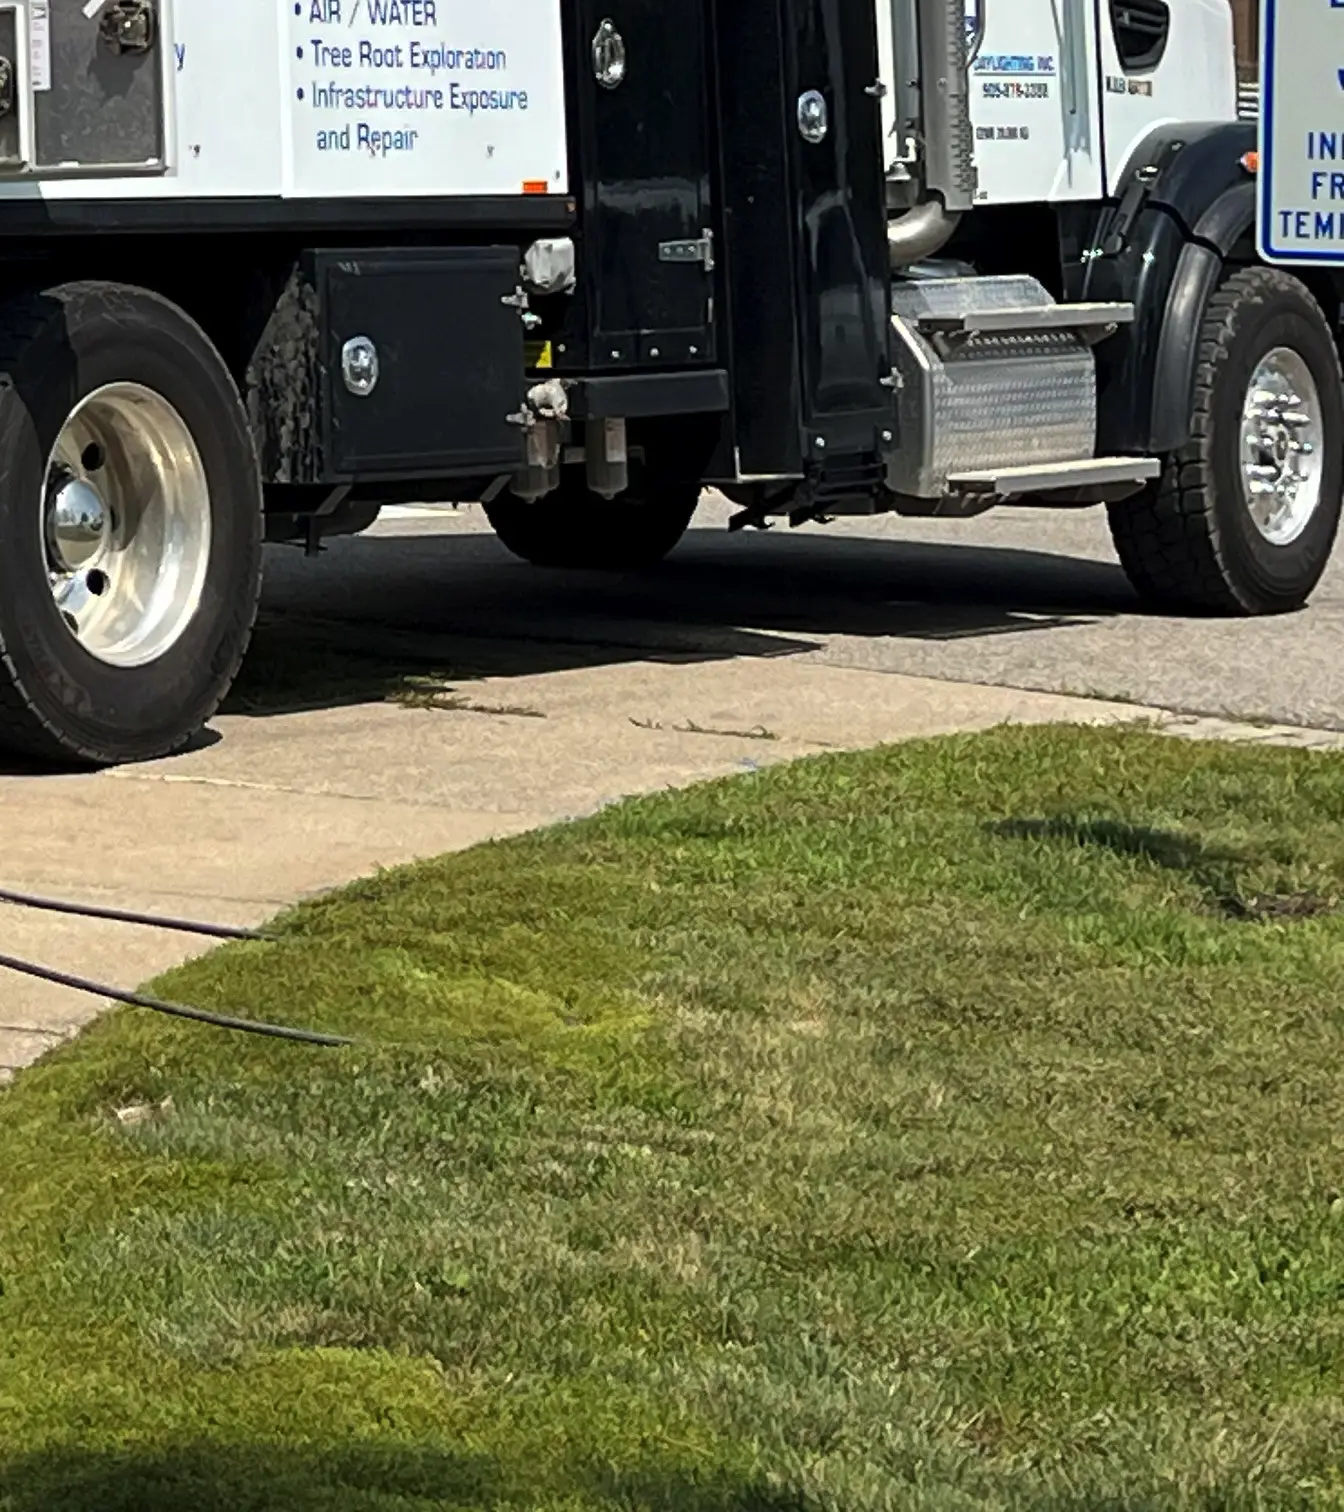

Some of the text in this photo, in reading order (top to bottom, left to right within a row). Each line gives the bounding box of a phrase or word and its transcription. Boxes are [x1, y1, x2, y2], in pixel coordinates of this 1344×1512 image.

[367, 0, 438, 27] WATER
[311, 39, 508, 76] Tree Root Exploration
[312, 80, 529, 118] Infrastructure Exposure
[317, 122, 419, 157] and Repair
[1308, 131, 1344, 160] IN
